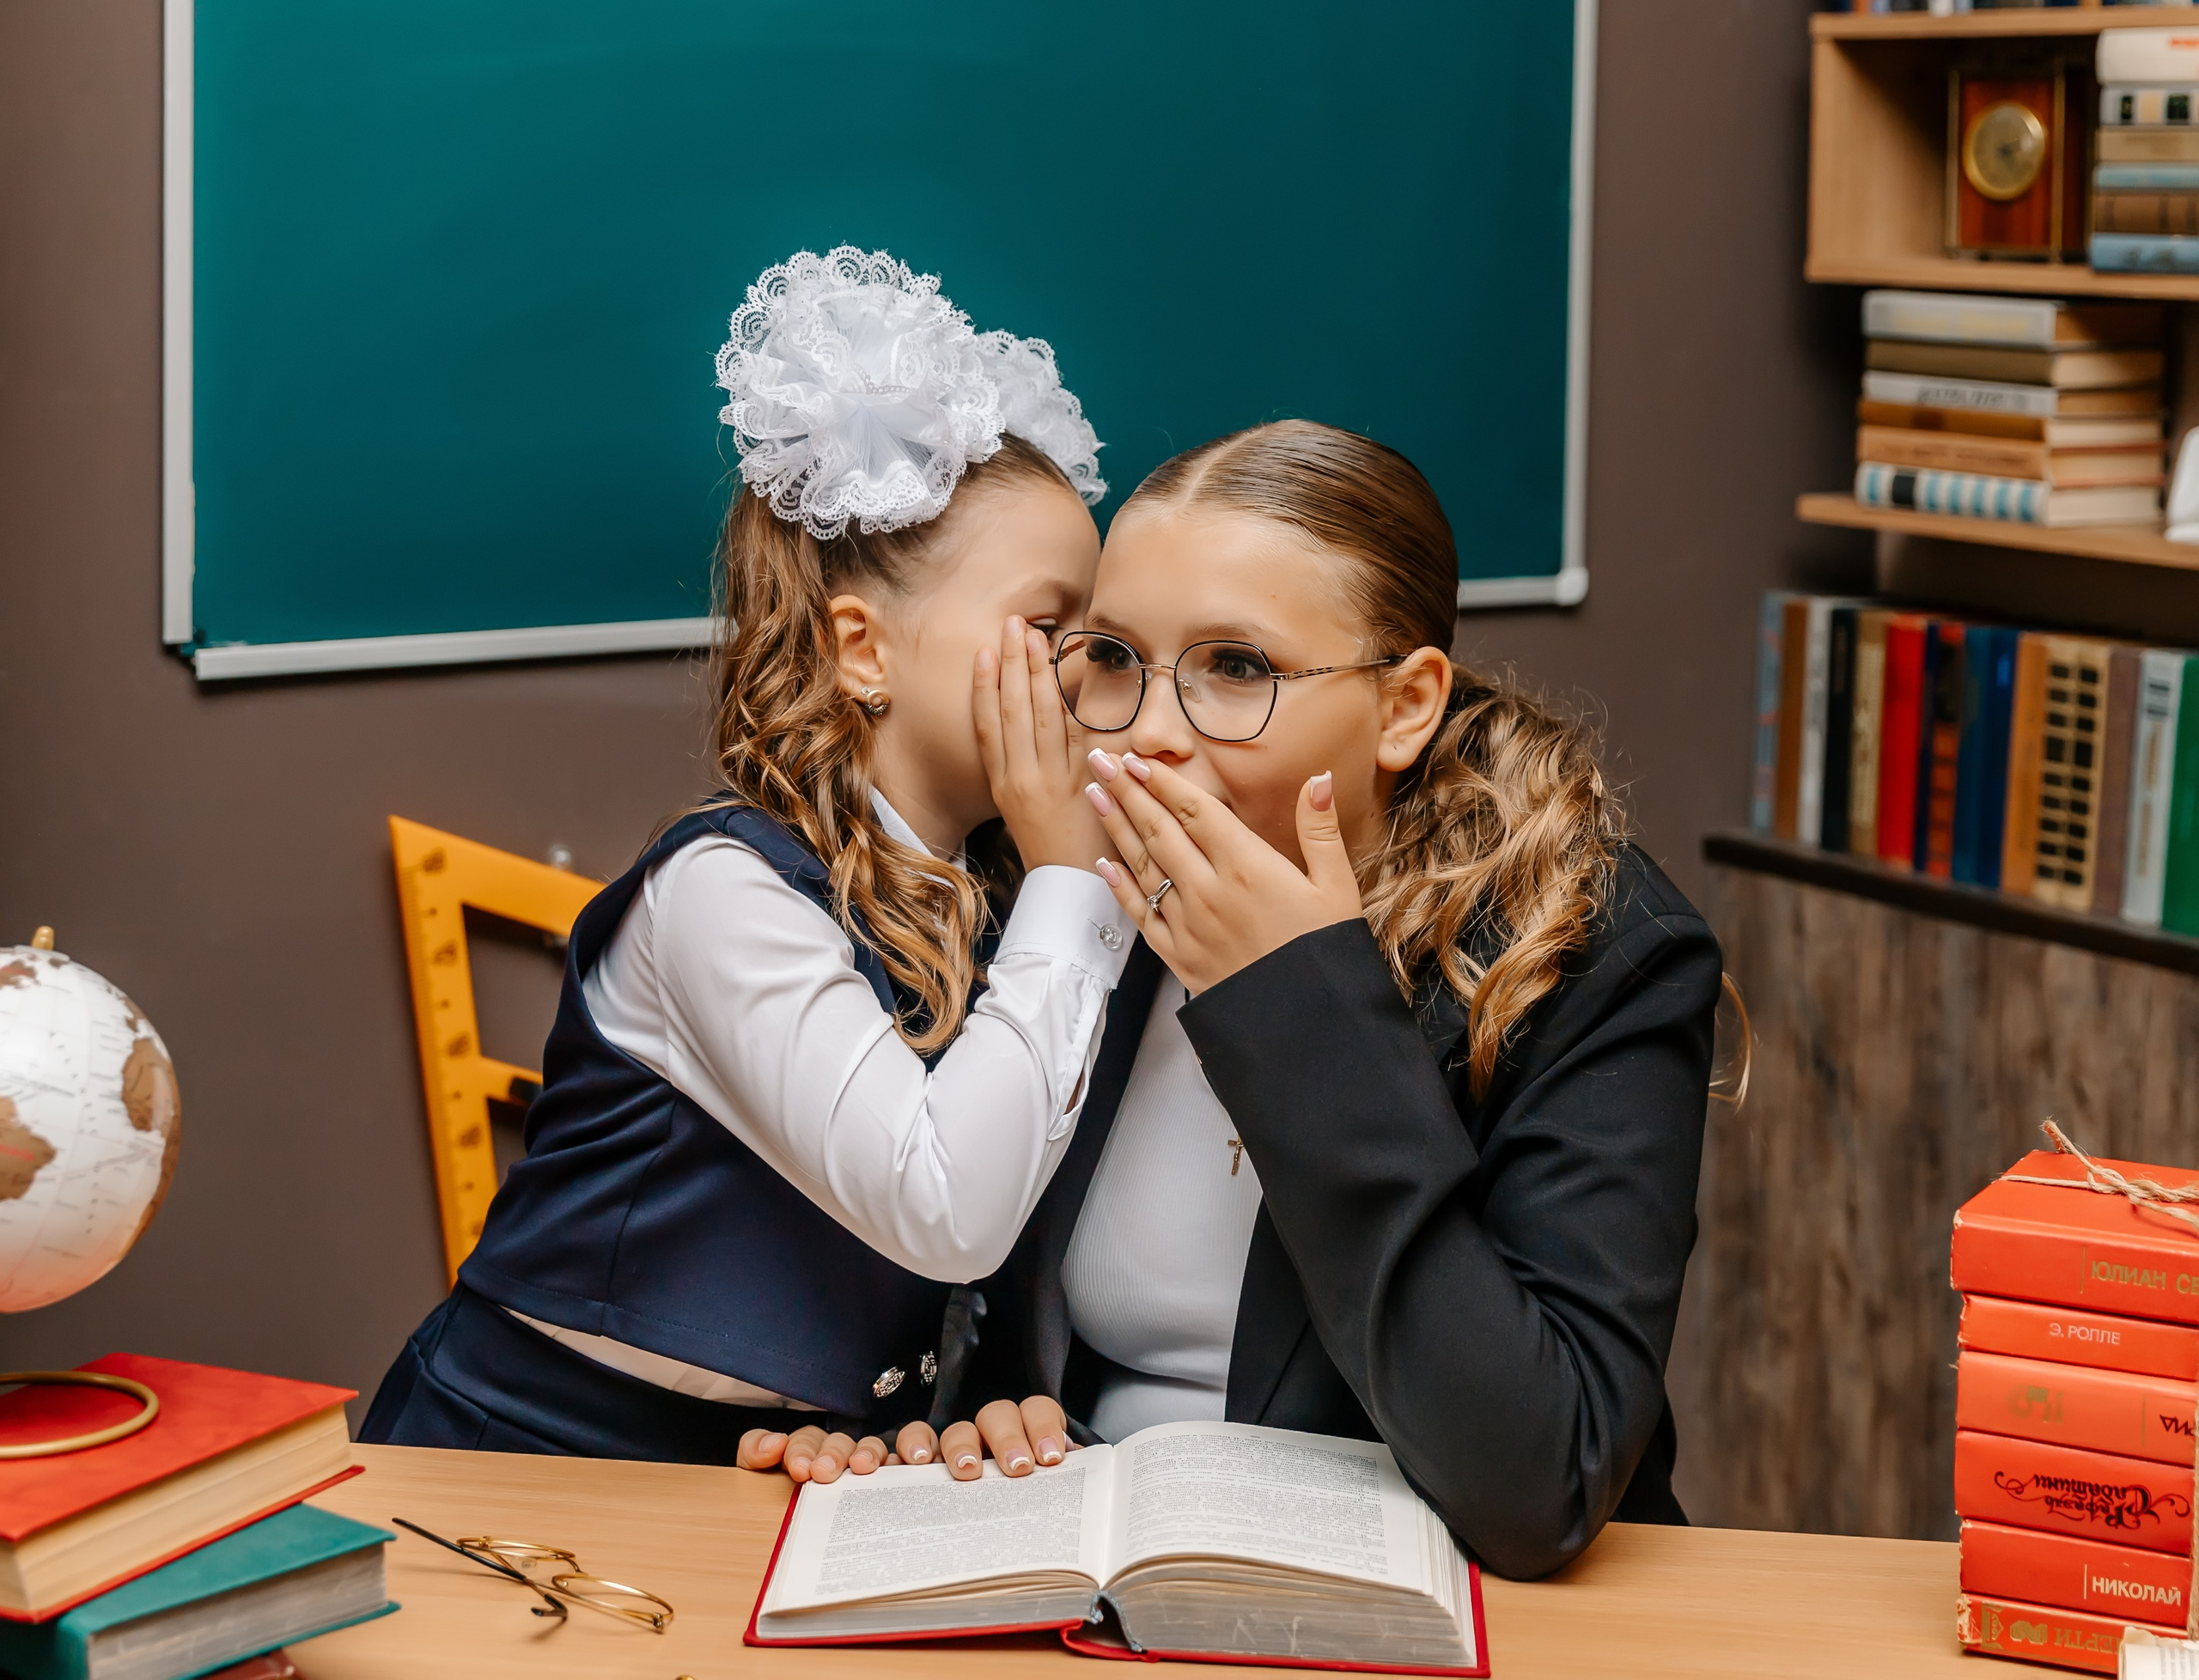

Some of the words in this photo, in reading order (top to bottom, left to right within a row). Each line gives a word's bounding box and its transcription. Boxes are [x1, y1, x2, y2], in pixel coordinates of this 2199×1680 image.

[2092, 1260, 2166, 1289] ЮЛИАН
[2050, 1323, 2064, 1337] Э.
[2068, 1325, 2121, 1345] РОЛЛЕ
[2092, 1576, 2181, 1606] НИКОЛАЙ
